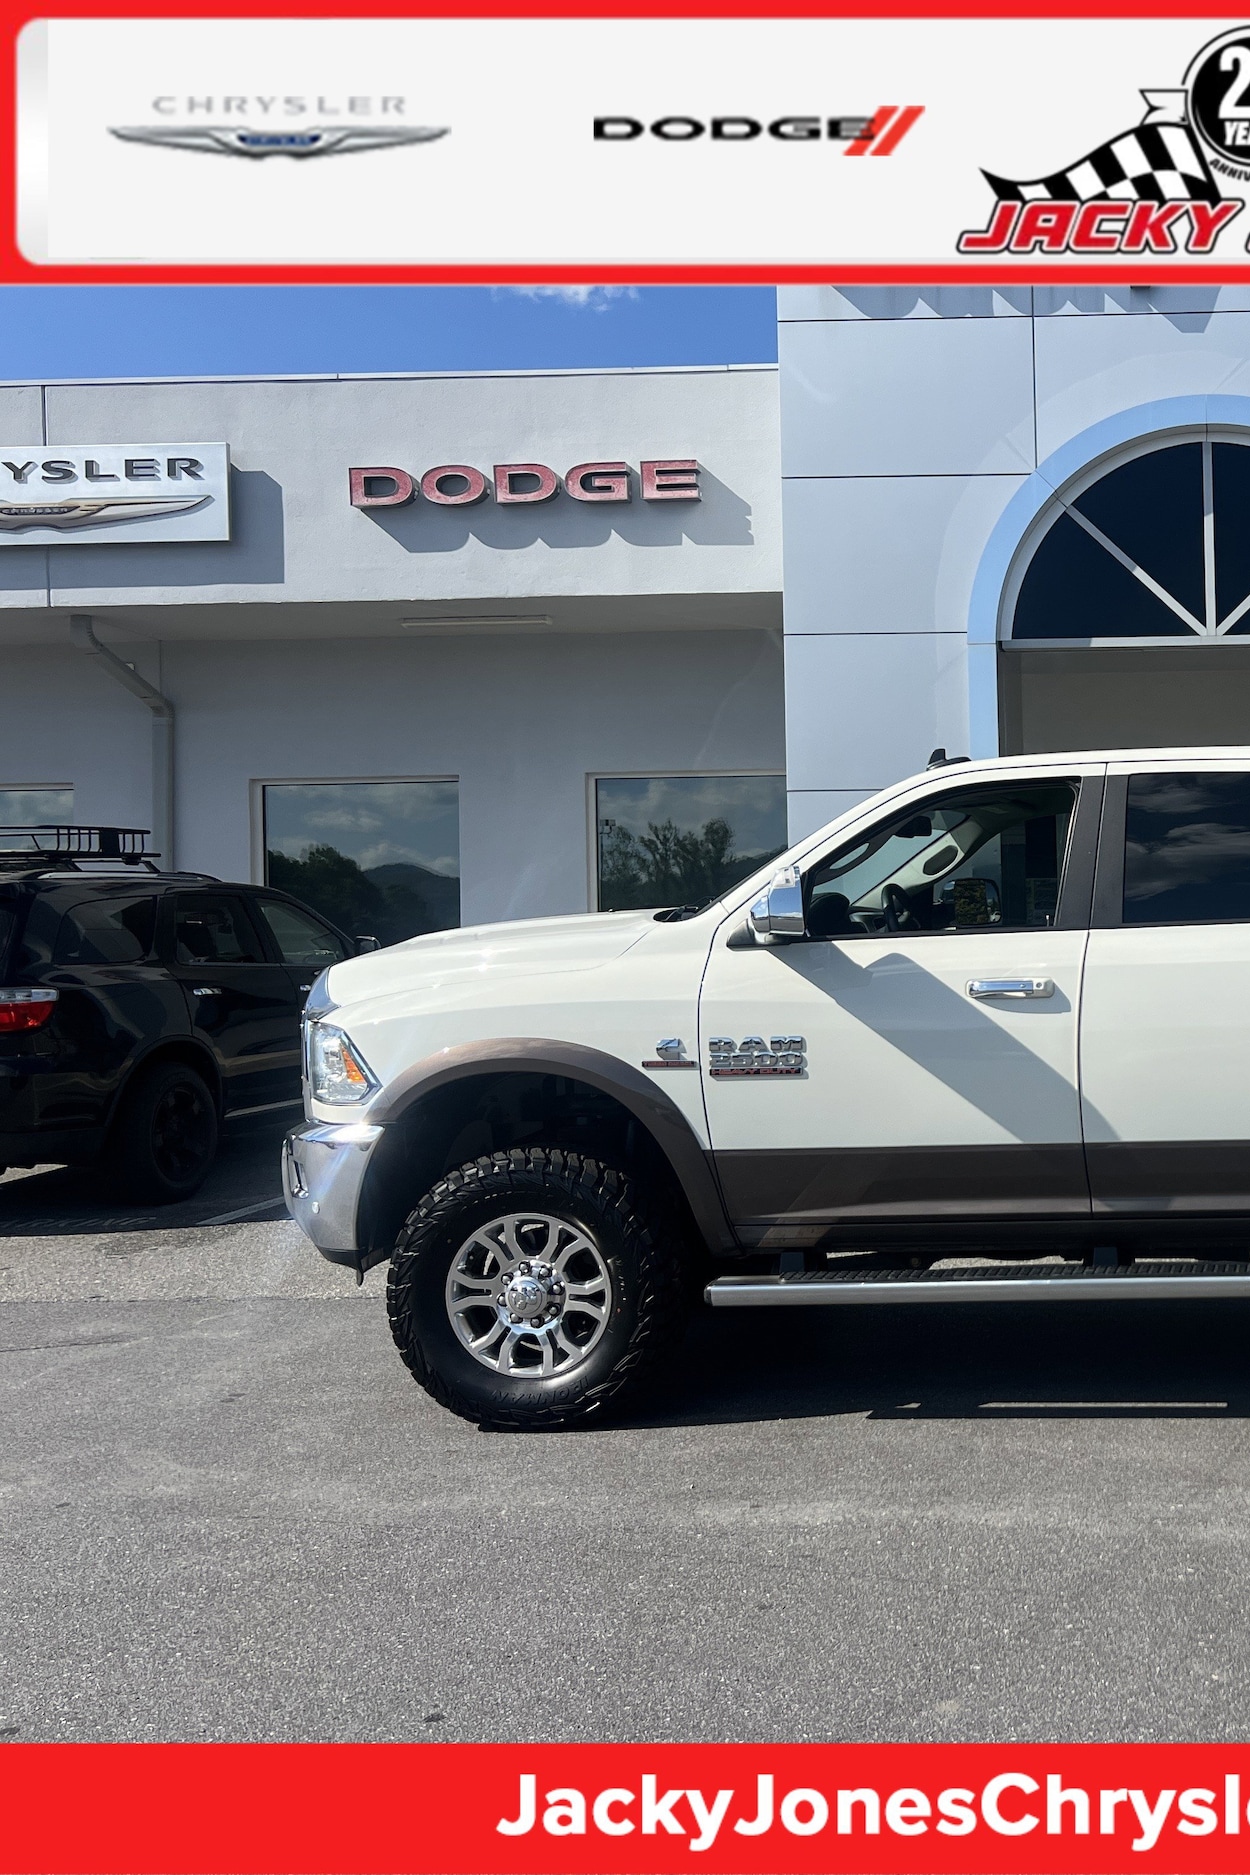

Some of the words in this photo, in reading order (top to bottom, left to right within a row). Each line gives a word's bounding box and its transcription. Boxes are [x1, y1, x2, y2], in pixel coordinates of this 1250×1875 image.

[1, 457, 204, 483] YSLER
[349, 460, 701, 509] DODGE
[709, 1036, 803, 1052] RAM
[709, 1052, 803, 1067] 2500
